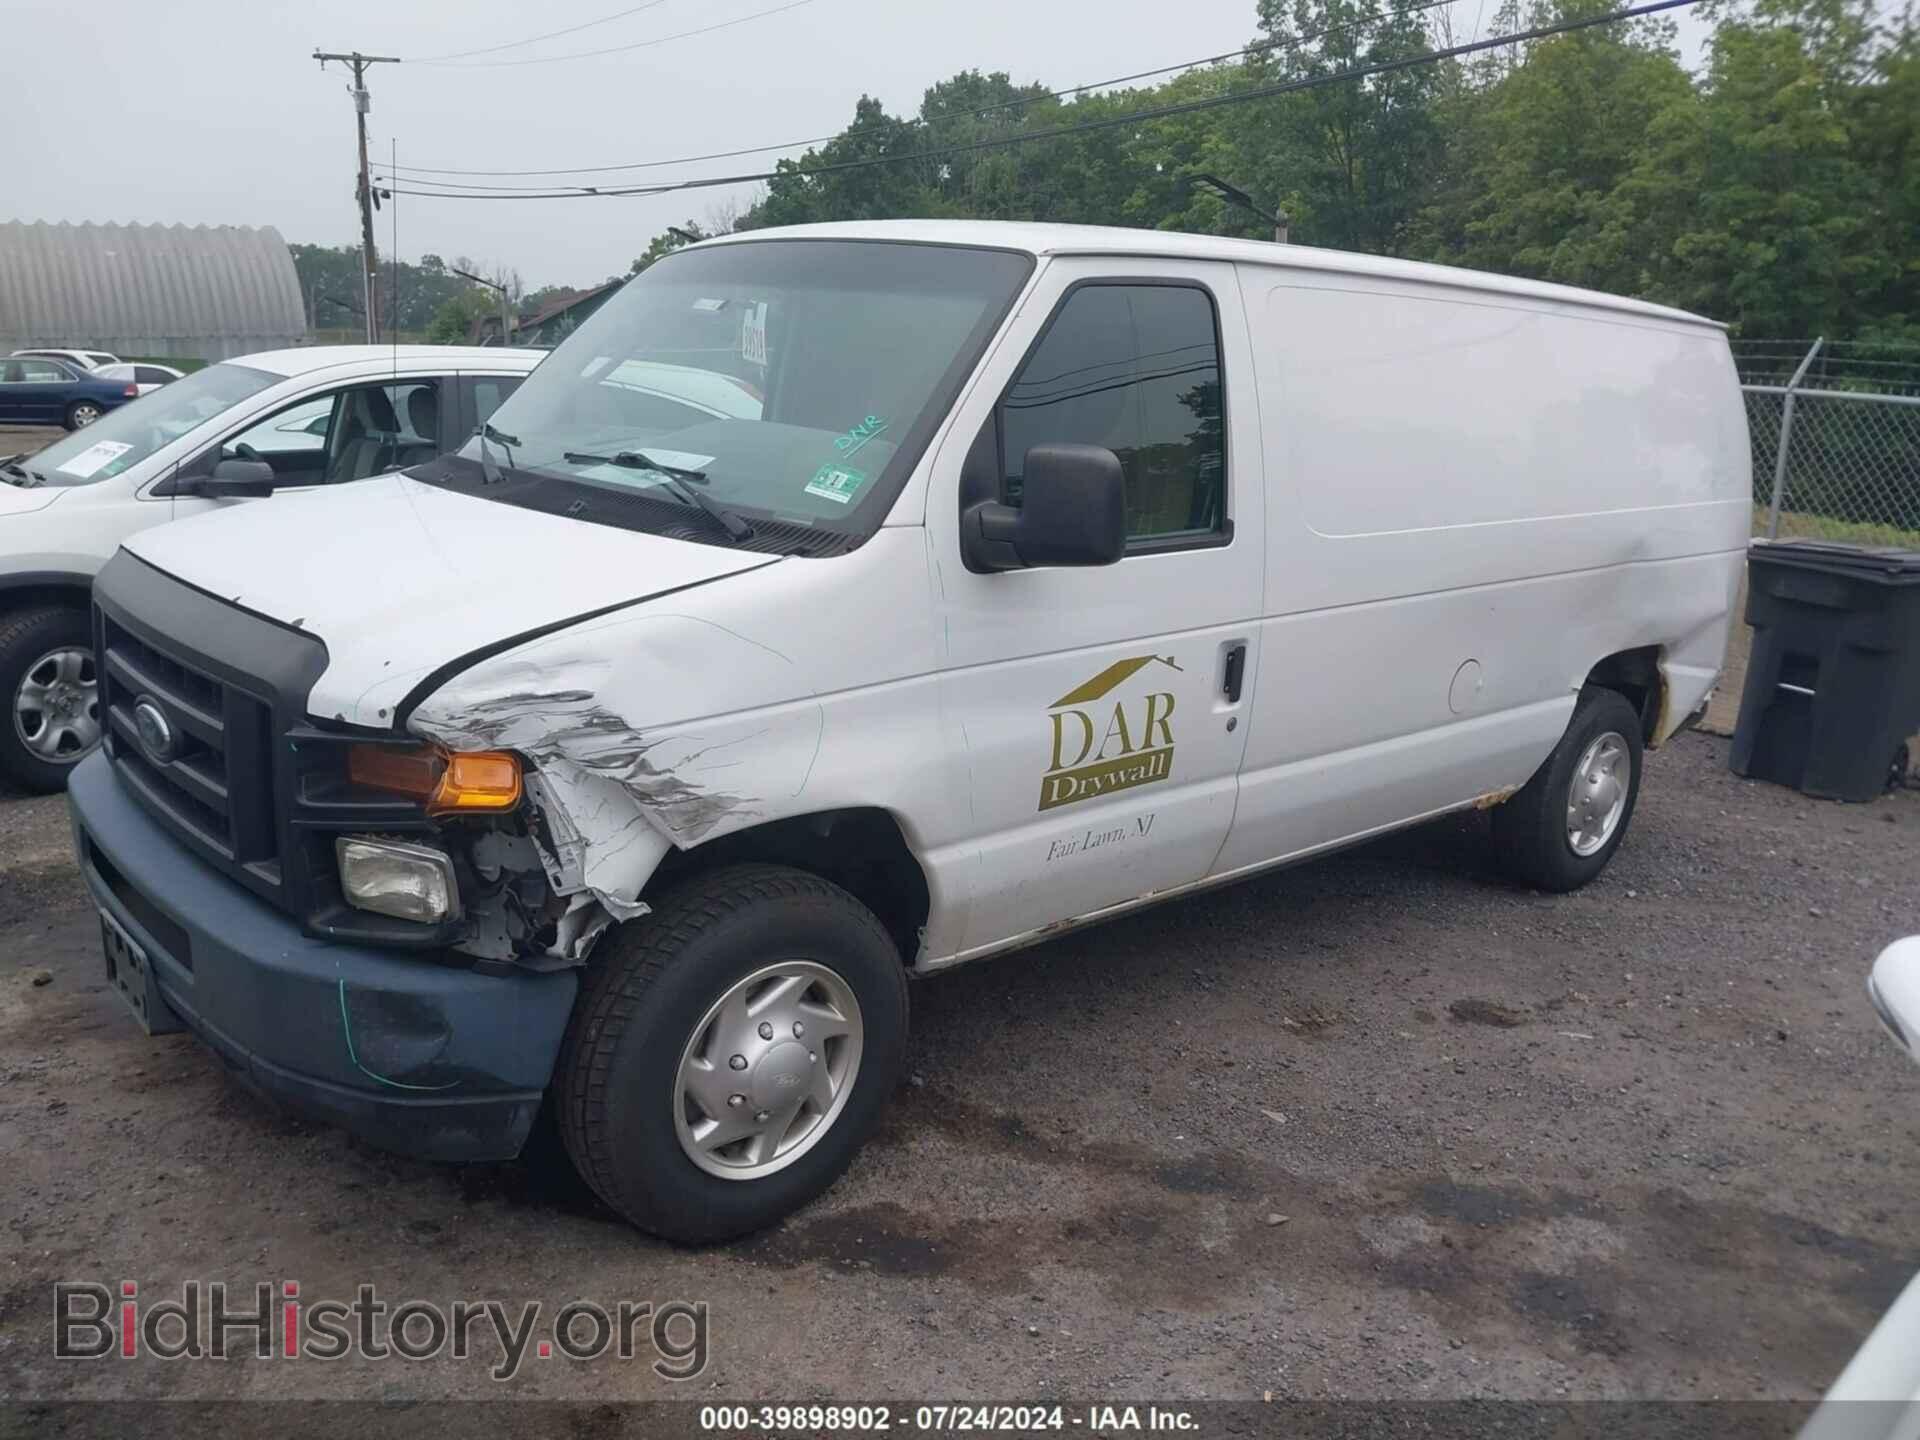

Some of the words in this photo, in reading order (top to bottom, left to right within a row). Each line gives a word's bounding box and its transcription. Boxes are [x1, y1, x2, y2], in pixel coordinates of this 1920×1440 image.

[1047, 693, 1176, 773] DAR
[1050, 754, 1165, 801] Drywall
[1047, 840, 1076, 861] Fair
[1130, 814, 1156, 837] NJ
